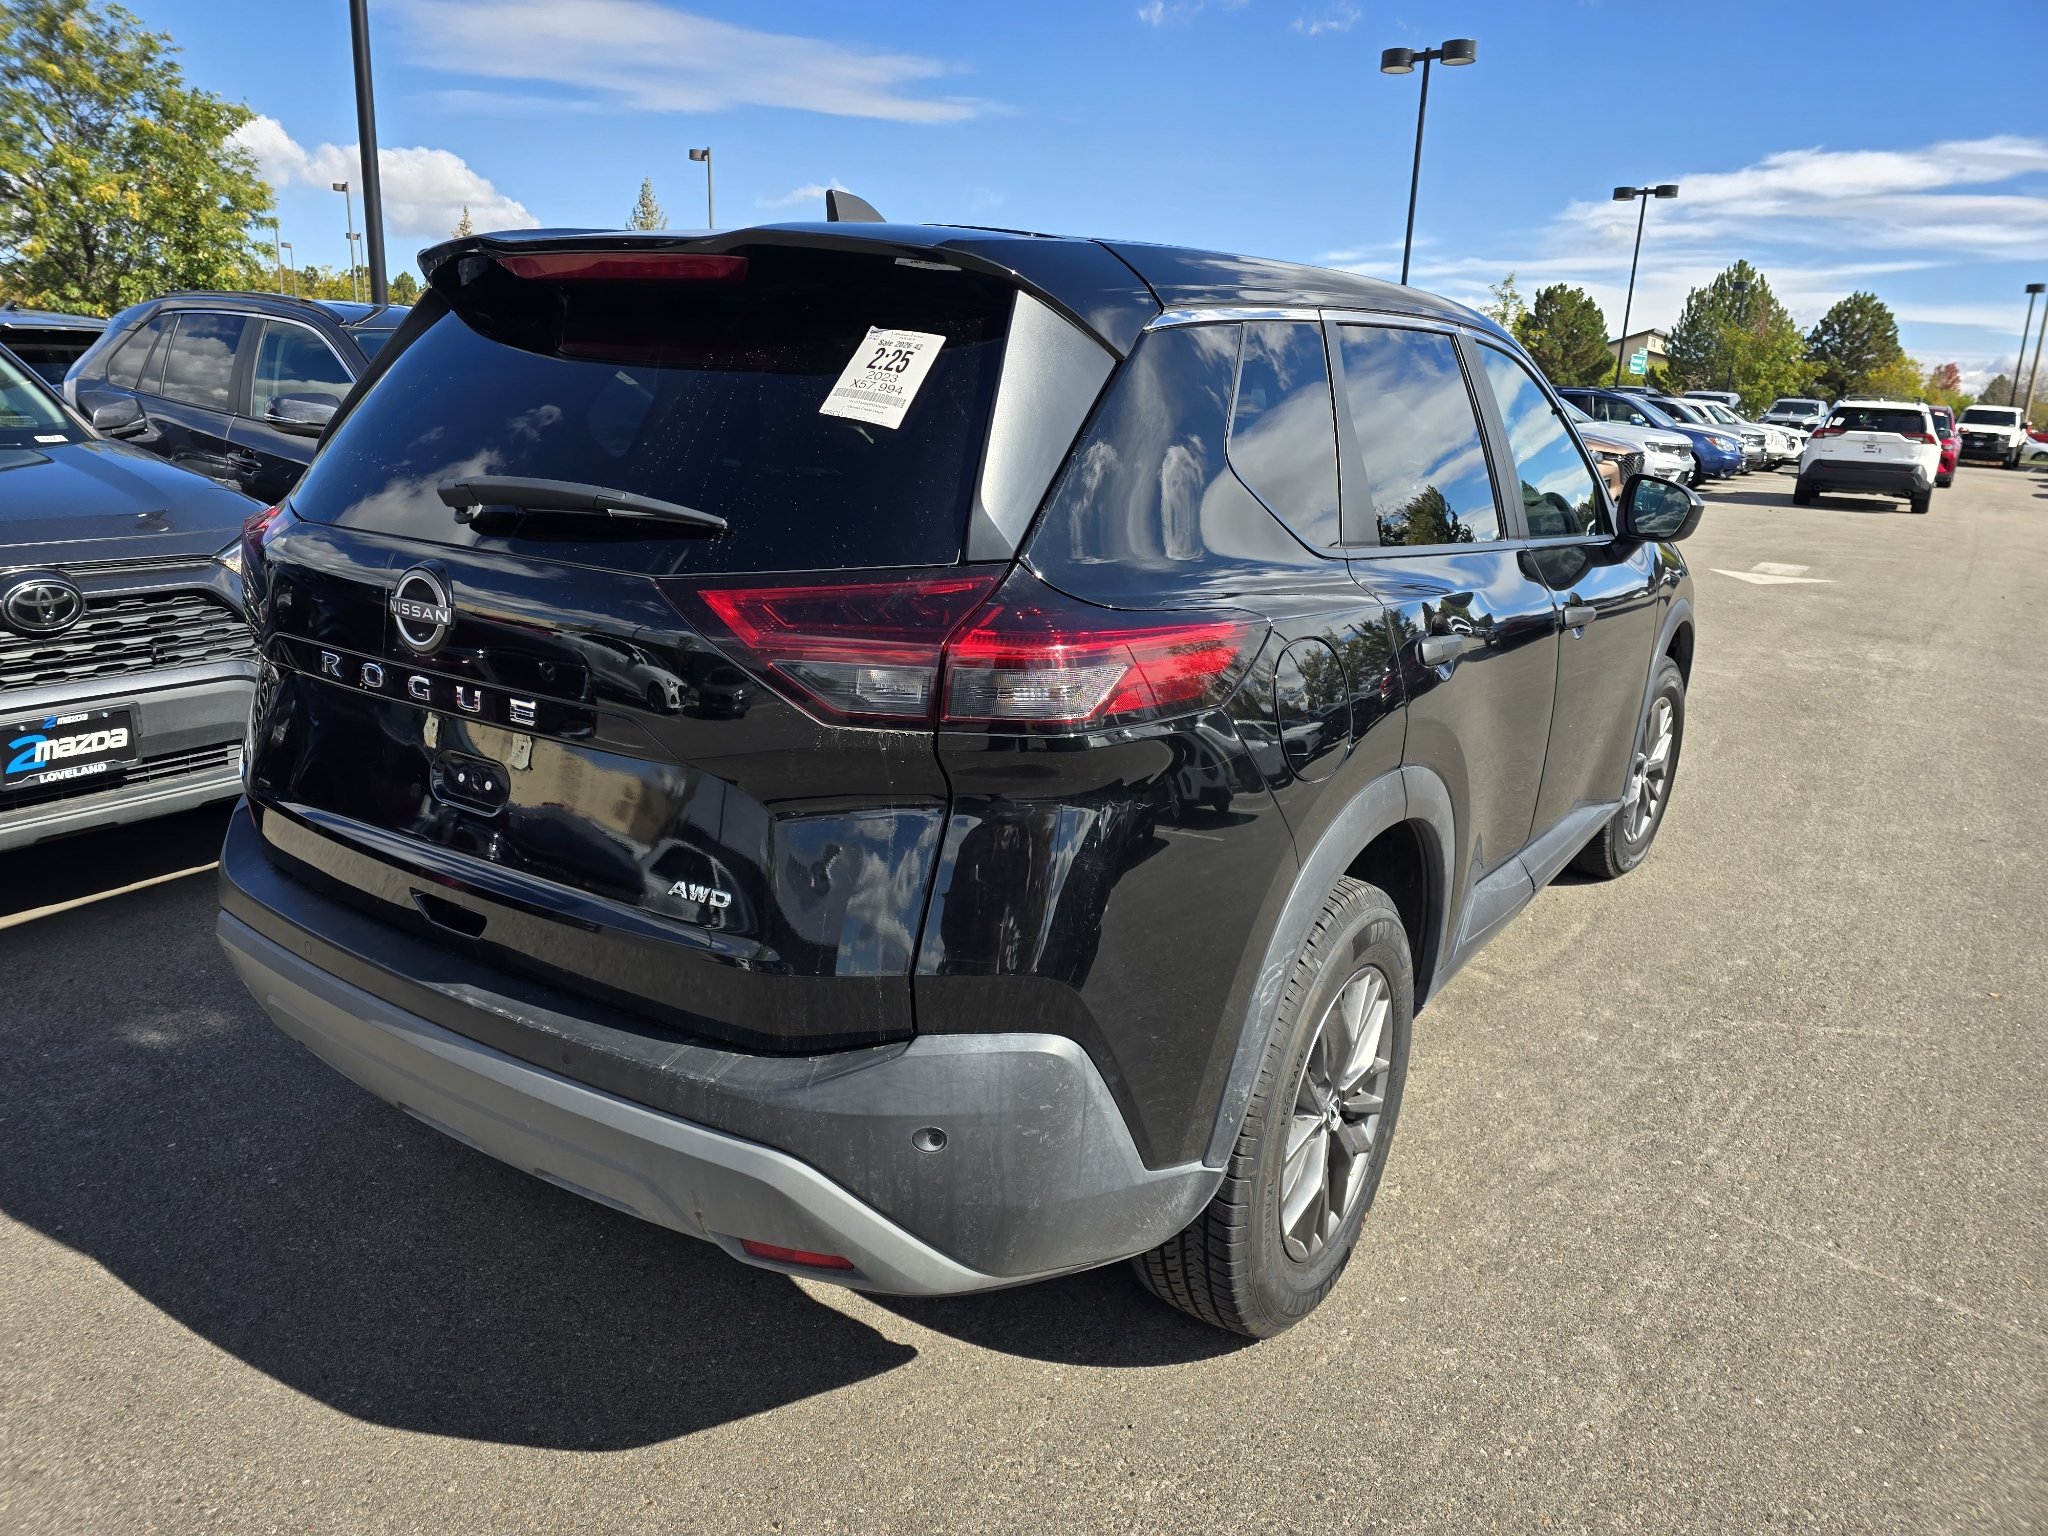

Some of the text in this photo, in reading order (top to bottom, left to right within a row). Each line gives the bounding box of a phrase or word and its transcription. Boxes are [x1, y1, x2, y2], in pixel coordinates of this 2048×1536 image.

[877, 339, 894, 347] Sale
[866, 347, 915, 373] 2:25
[849, 378, 904, 395] X57,994
[865, 370, 899, 383] 2023
[390, 597, 450, 624] NISSAN
[321, 650, 537, 727] ROGUE
[39, 763, 107, 784] LOVELAND
[667, 880, 732, 908] AWD
